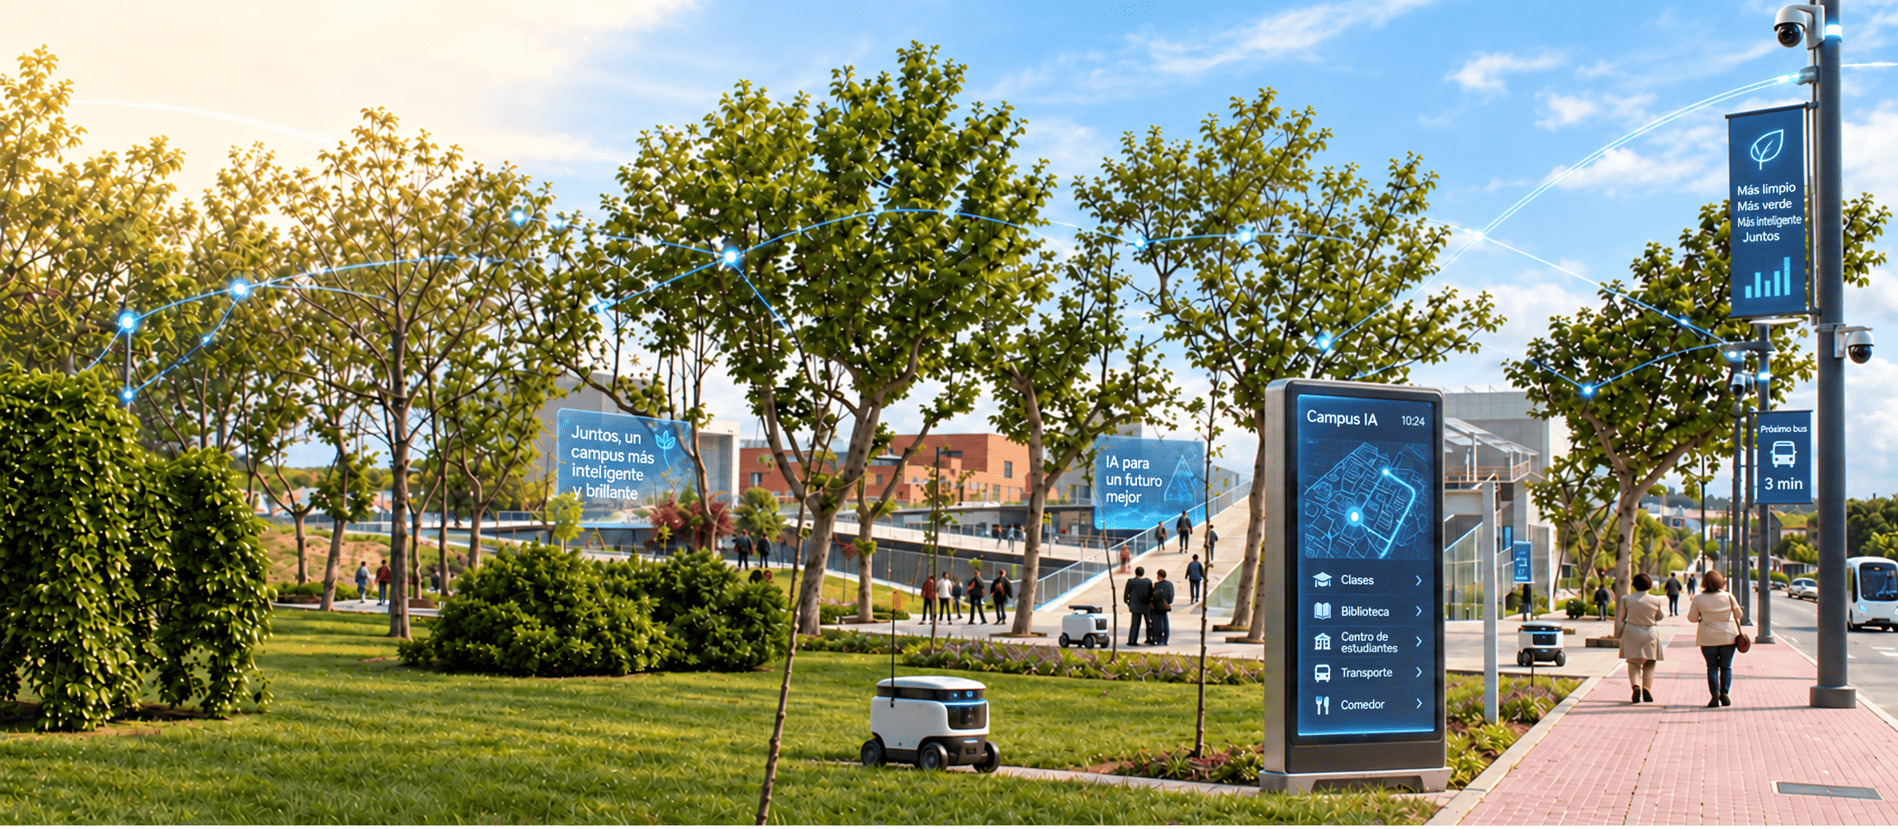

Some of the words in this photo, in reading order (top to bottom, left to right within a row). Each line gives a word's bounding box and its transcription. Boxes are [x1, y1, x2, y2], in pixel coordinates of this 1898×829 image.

[1737, 185, 1760, 196] Más
[1762, 182, 1797, 195] limpio
[1737, 200, 1760, 211] Más
[1762, 198, 1792, 210] verde
[1737, 216, 1755, 227] Más
[1756, 214, 1802, 228] inteligente
[1742, 231, 1780, 243] Juntos
[1307, 409, 1361, 427] Campus
[1364, 412, 1378, 426] IA
[1401, 415, 1426, 427] 10:24
[571, 425, 622, 445] Juntos,
[625, 433, 641, 444] un
[1760, 424, 1792, 434] Próximo
[1793, 424, 1808, 433] bus
[571, 447, 624, 464] campus
[628, 450, 655, 464] más
[1106, 455, 1119, 468] IA
[1122, 458, 1150, 472] para
[572, 462, 644, 483] inteligente
[1106, 475, 1122, 486] un
[1125, 473, 1163, 487] futuro
[1764, 477, 1774, 490] 3
[1777, 477, 1803, 490] min
[573, 485, 582, 501] y
[586, 483, 638, 500] brillante
[1106, 490, 1142, 507] mejor
[1341, 574, 1375, 585] Clases
[1341, 606, 1390, 617] Biblioteca
[1341, 631, 1374, 642] Centro
[1376, 631, 1389, 642] de
[1341, 643, 1398, 653] estudiantes
[1341, 667, 1393, 680] Transporte
[1341, 699, 1385, 710] Comedor
